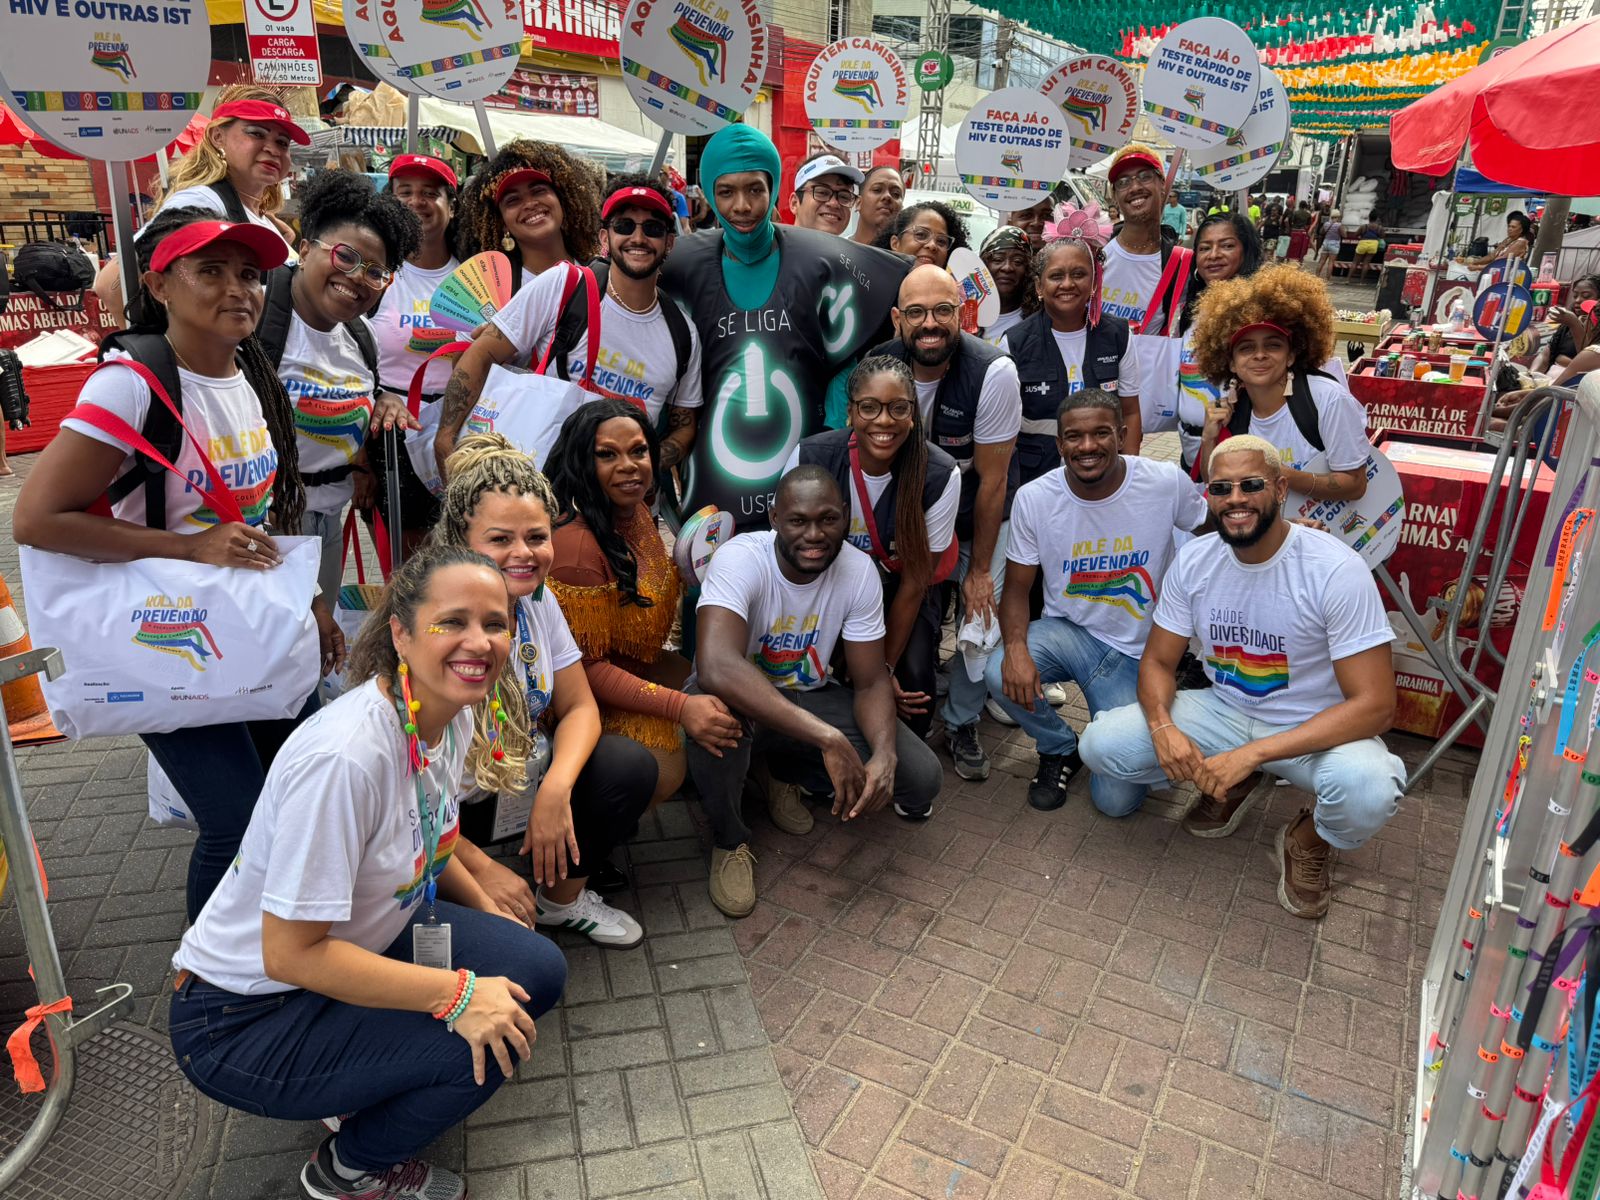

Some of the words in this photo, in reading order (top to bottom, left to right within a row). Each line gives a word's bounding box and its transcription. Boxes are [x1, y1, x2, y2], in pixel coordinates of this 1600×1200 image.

[10, 0, 48, 16] HIV
[56, 0, 71, 18] E
[75, 1, 159, 23] OUTRAS
[164, 7, 191, 24] IST
[523, 0, 621, 42] RAHMA
[276, 26, 295, 34] vaga
[267, 38, 296, 47] CARGA
[1178, 38, 1211, 58] FAÇA
[1213, 48, 1230, 62] JÁ
[1231, 55, 1241, 65] O
[261, 47, 305, 57] DESCARGA
[257, 60, 314, 72] CAMINHÕES
[806, 64, 823, 103] AQUI
[819, 40, 848, 63] TEM
[851, 38, 907, 106] CAMISINHA!
[1162, 48, 1193, 65] TESTE
[1194, 57, 1235, 76] RÁPIDO
[1235, 69, 1252, 82] DE
[1157, 59, 1176, 72] HIV
[1177, 65, 1184, 75] E
[1185, 67, 1229, 89] OUTRAS
[1230, 80, 1249, 93] IST
[1058, 58, 1093, 78] TEM
[1096, 59, 1137, 136] CAMISINHA!
[1259, 87, 1275, 100] DE
[1258, 99, 1276, 113] IST
[987, 109, 1020, 124] FAÇA
[1022, 111, 1039, 125] JÁ
[1041, 116, 1050, 126] O
[970, 121, 1004, 133] TESTE
[1006, 122, 1046, 137] RÁPIDO
[1047, 129, 1063, 139] DE
[968, 132, 988, 143] HIV
[989, 134, 997, 143] E
[998, 135, 1042, 148] OUTRAS
[1044, 139, 1062, 150] IST
[952, 200, 971, 210] TAXI
[839, 253, 852, 269] SE
[852, 264, 871, 292] LIGA
[5, 297, 44, 313] NAVAL
[33, 309, 89, 329] ABERTAS
[717, 312, 737, 339] SE
[744, 308, 792, 333] LIGA
[1024, 385, 1038, 393] SUS
[1364, 403, 1426, 420] CARNAVAL
[1431, 405, 1447, 420] TÁ
[1451, 408, 1467, 422] DE
[1366, 416, 1407, 431] AHMAS
[1410, 419, 1466, 436] ABERTAS
[1366, 464, 1379, 481] ST
[1112, 535, 1133, 553] DA
[1401, 523, 1454, 550] HMAS
[1556, 518, 1573, 573] LEMBRANÇA
[1210, 607, 1244, 625] SAÚDE
[1396, 674, 1439, 695] BRAHMA
